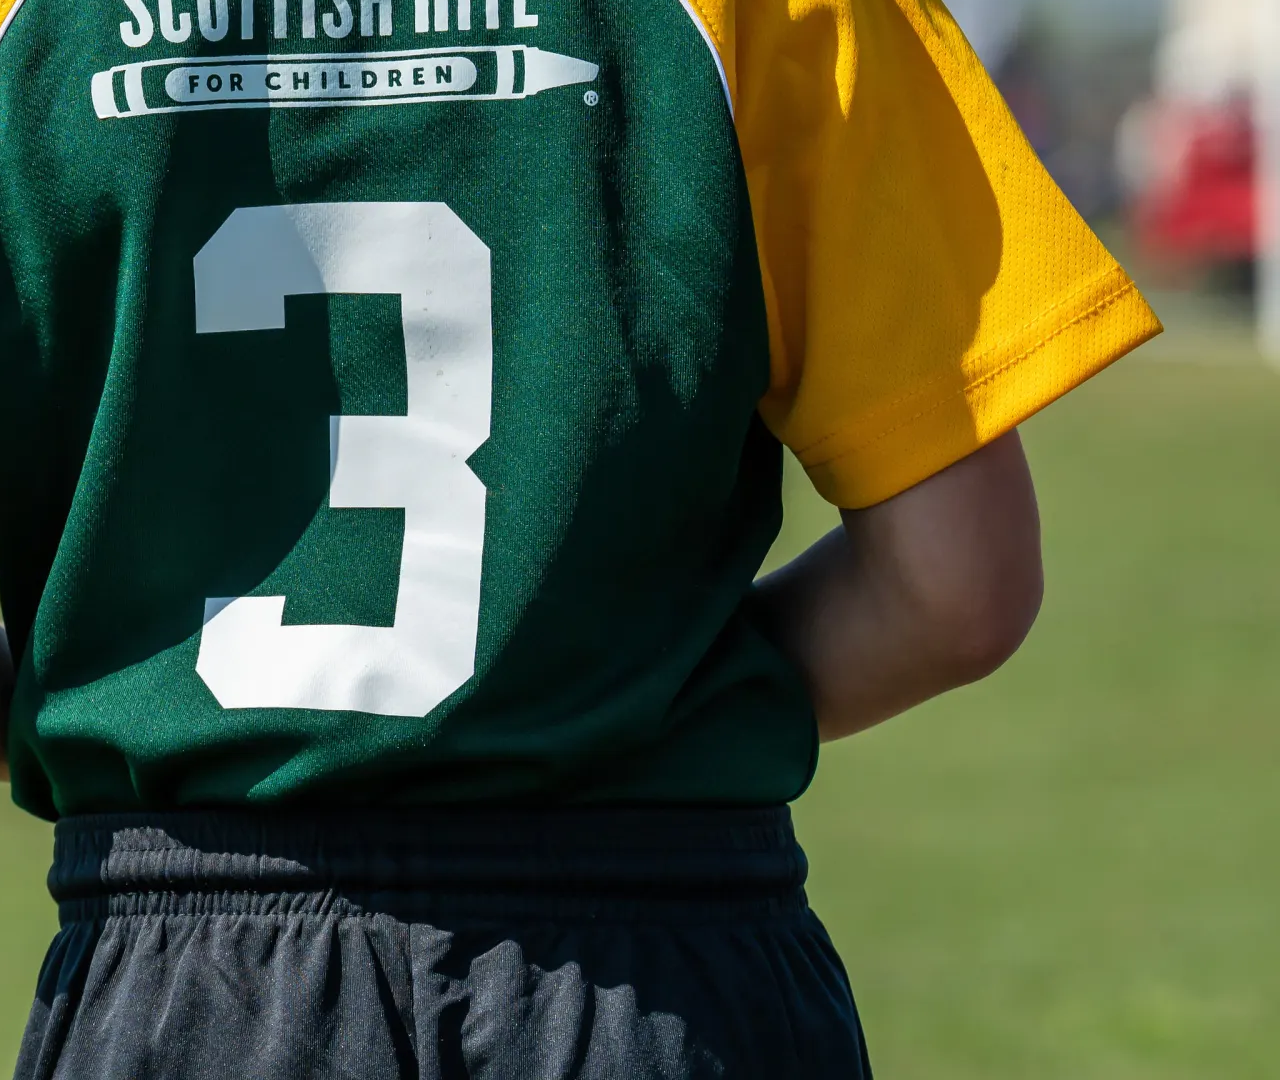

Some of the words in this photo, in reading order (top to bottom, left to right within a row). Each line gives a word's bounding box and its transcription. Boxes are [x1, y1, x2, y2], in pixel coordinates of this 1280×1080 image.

[188, 73, 245, 94] FOR
[264, 64, 454, 91] CHILDREN
[193, 201, 495, 716] 3
